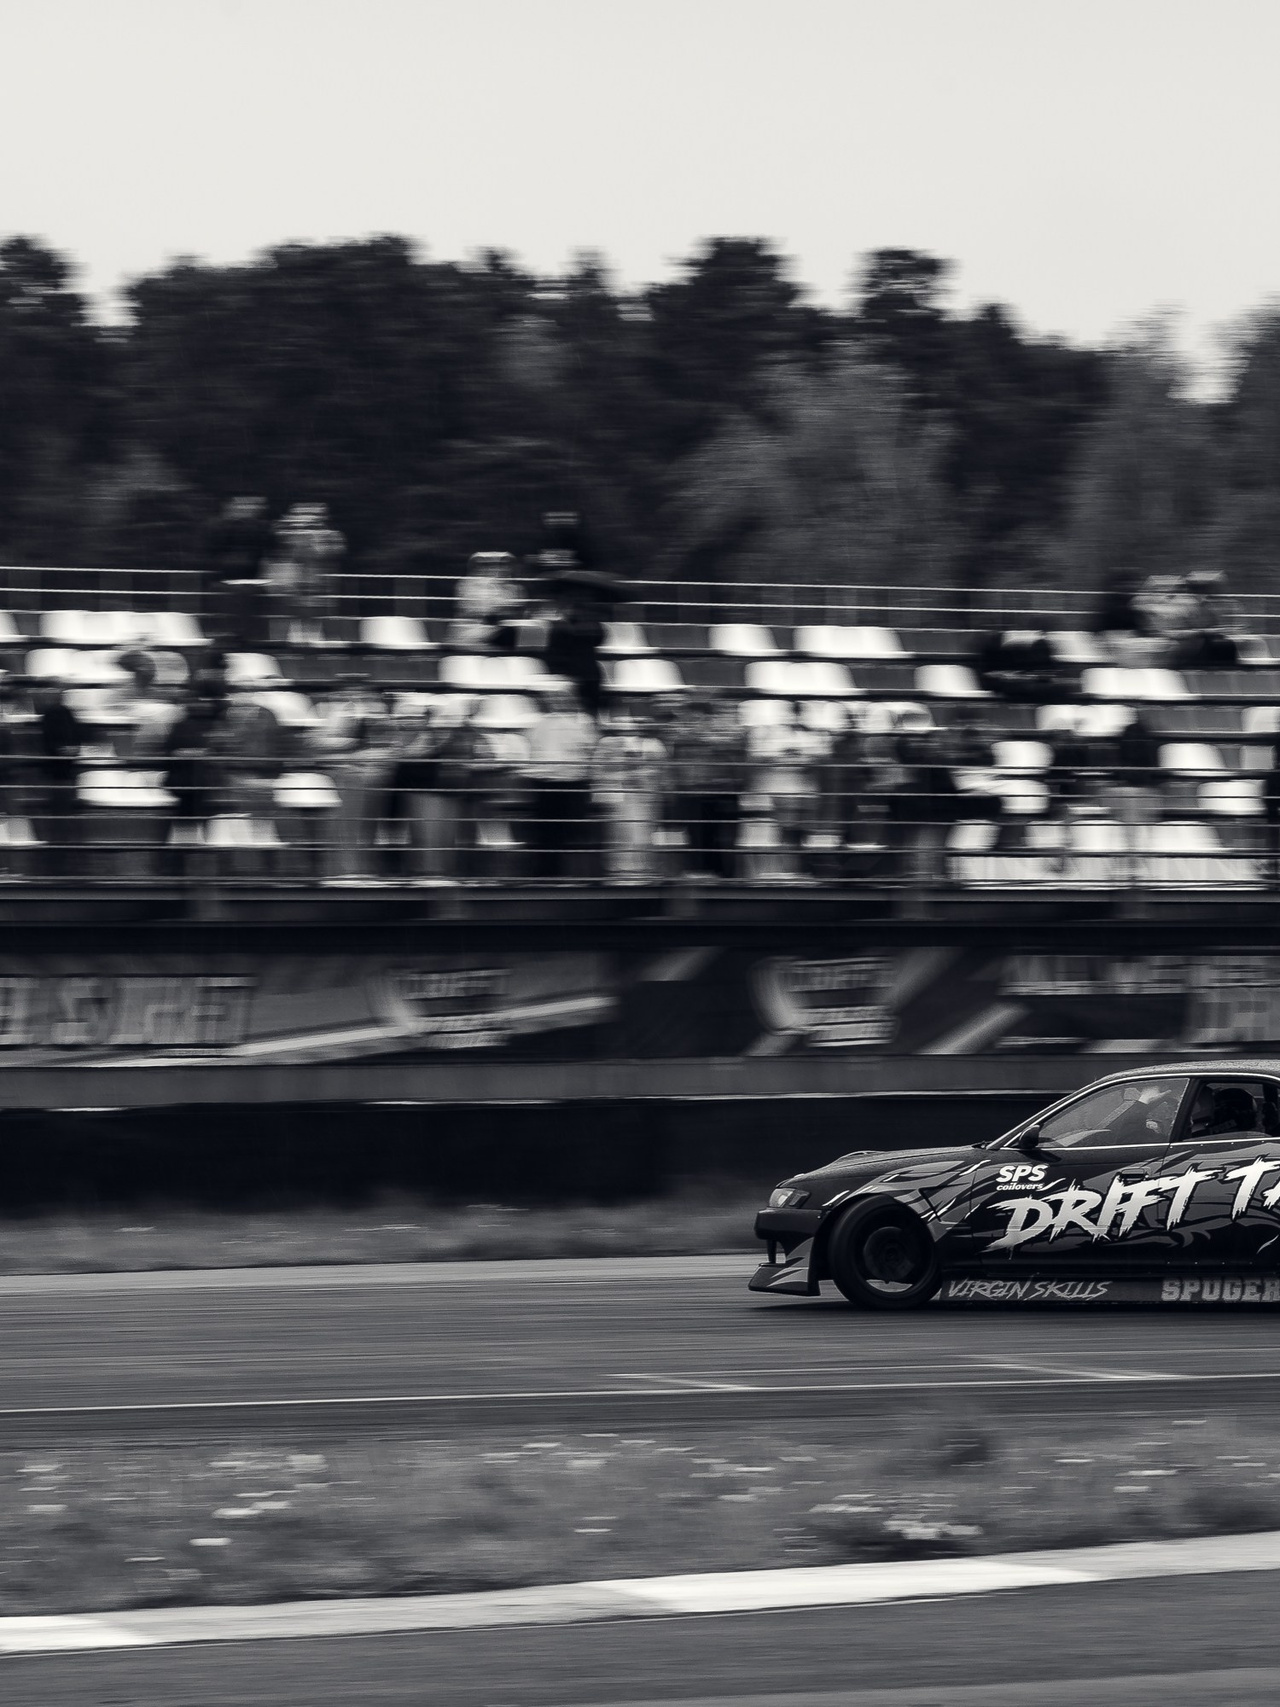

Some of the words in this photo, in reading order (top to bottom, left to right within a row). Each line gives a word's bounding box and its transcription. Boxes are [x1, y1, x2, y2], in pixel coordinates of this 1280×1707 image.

[996, 1164, 1049, 1182] SPS
[996, 1183, 1044, 1191] coilovers
[986, 1166, 1222, 1258] DRIFT
[949, 1277, 1032, 1300] VIRGIN
[1024, 1280, 1113, 1301] SKILLS
[1161, 1279, 1280, 1302] SPUGER
